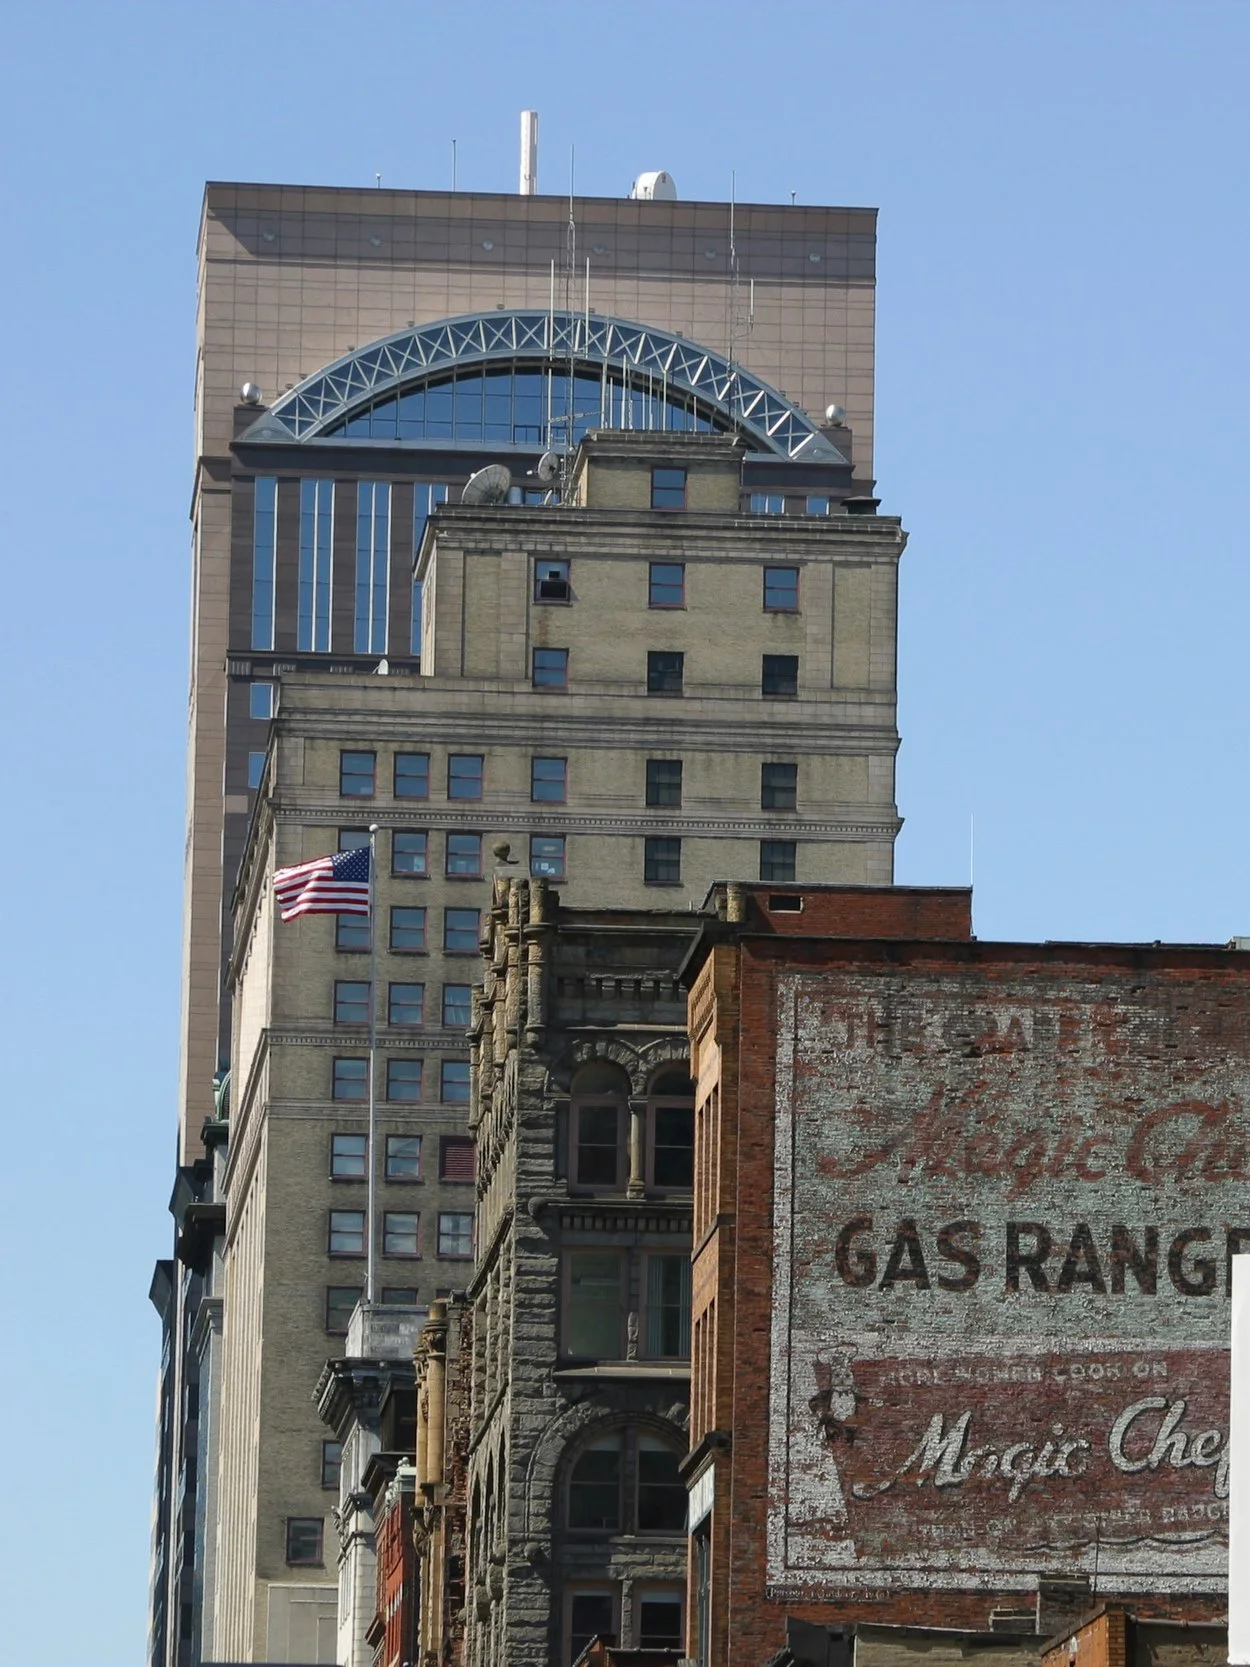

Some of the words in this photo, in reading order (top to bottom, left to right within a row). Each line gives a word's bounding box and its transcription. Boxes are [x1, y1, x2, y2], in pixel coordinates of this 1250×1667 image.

[834, 1216, 982, 1294] GAS
[1132, 1359, 1168, 1378] ON
[852, 1410, 1091, 1503] Magic
